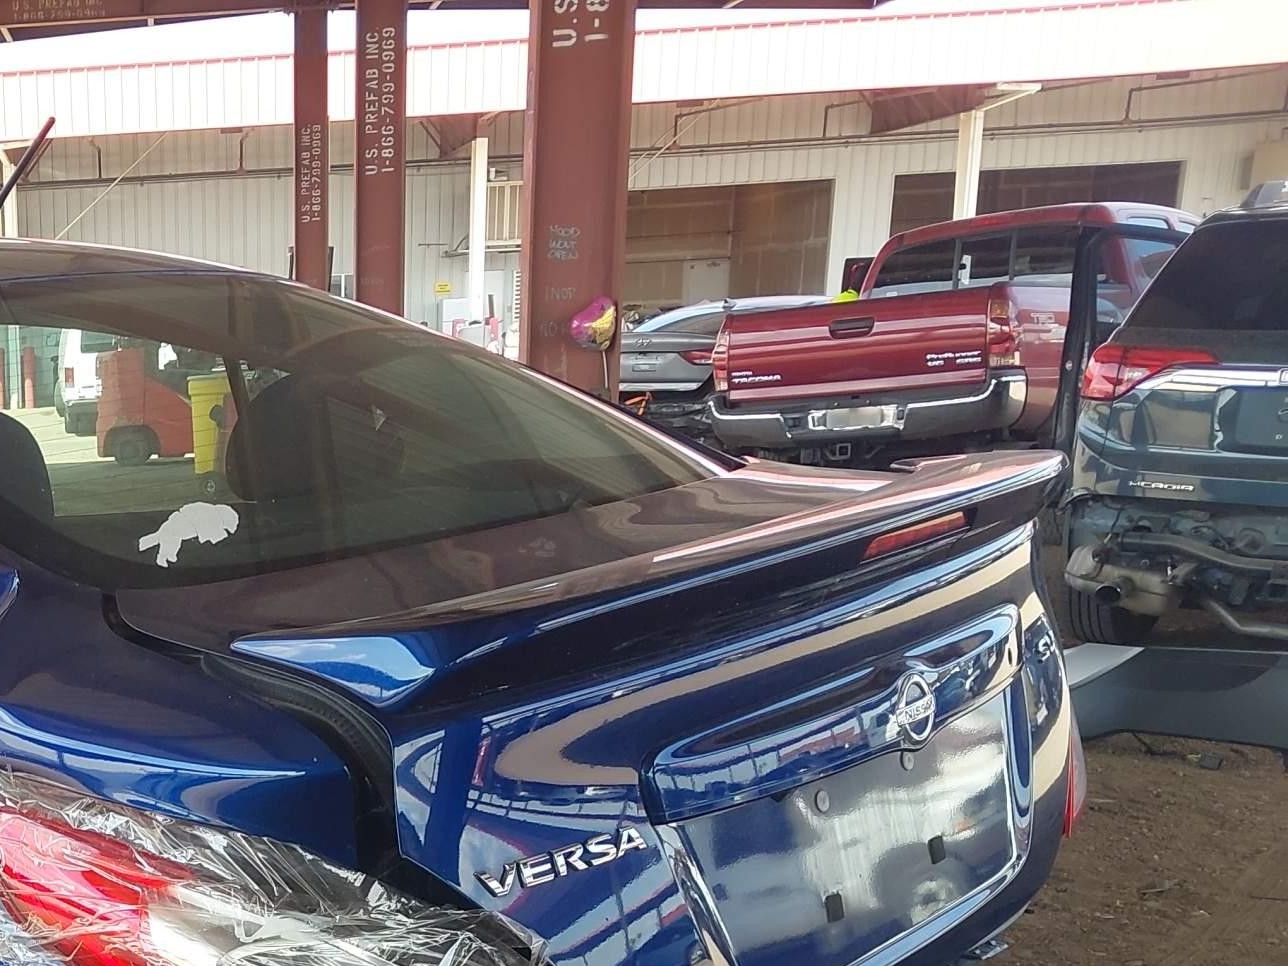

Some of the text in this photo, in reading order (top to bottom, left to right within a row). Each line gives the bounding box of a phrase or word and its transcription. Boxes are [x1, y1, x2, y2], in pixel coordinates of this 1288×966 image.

[365, 68, 379, 134] PREFAB
[381, 27, 396, 173] 1-866-799-0969
[300, 123, 311, 223] U.S. PREFAB INC.
[312, 124, 321, 222] 1-866-799-0969
[365, 142, 379, 176] U.S.
[473, 825, 648, 897] VERSA
